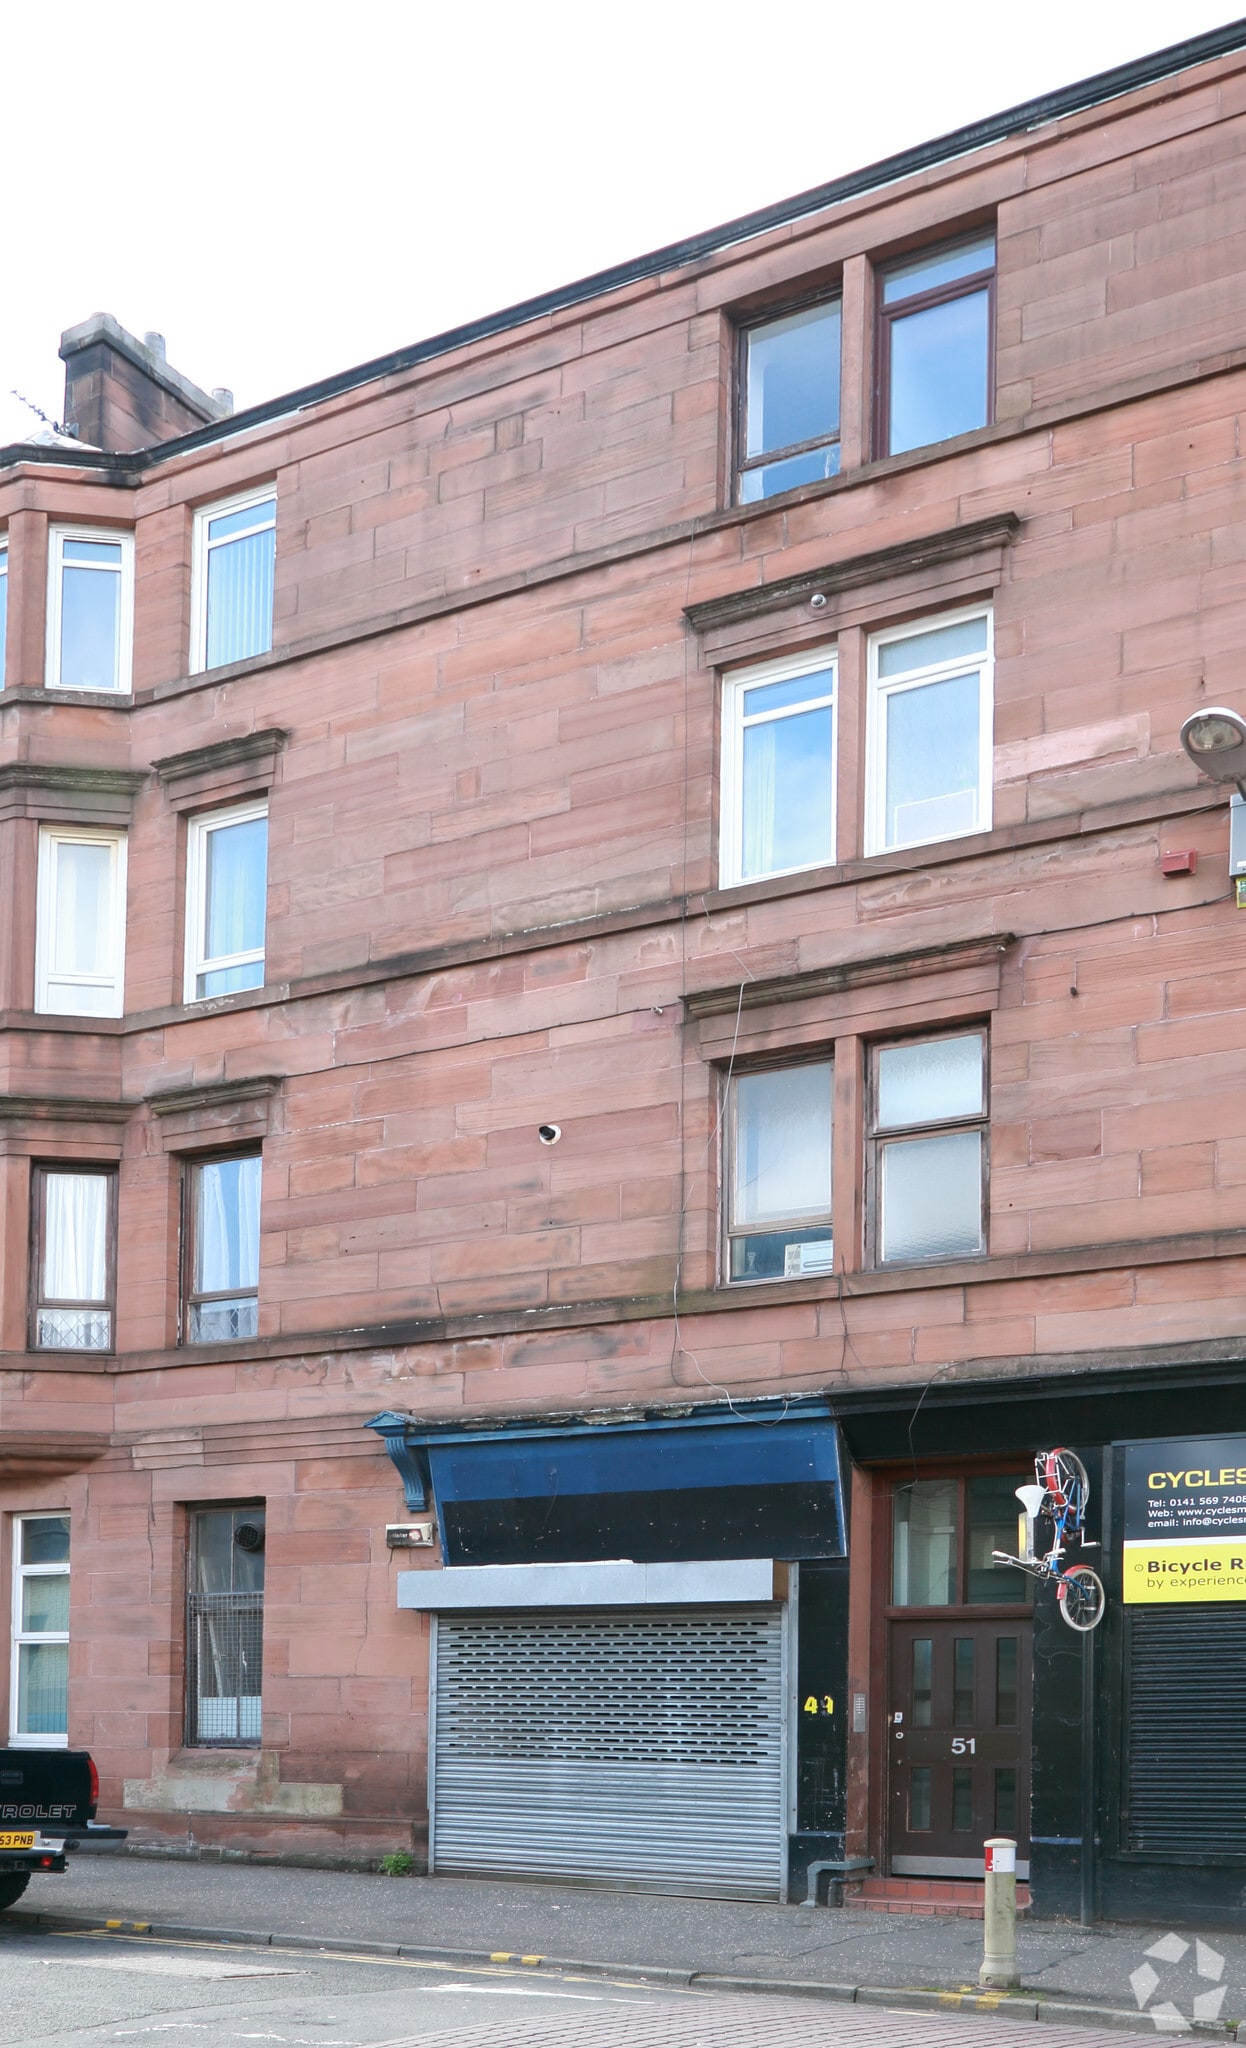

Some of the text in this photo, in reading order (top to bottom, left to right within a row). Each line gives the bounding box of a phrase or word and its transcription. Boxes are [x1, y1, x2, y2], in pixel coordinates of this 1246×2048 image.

[1148, 1467, 1246, 1489] CYCLES
[1147, 1499, 1166, 1508] Tel:
[1169, 1498, 1195, 1507] 0141
[1199, 1497, 1219, 1505] 569
[1148, 1509, 1174, 1518] Web:
[1147, 1516, 1246, 1528] email: info@cycles
[1147, 1558, 1246, 1575] Bicycle R
[1147, 1575, 1246, 1589] by experienc
[951, 1737, 976, 1755] 51
[0, 1804, 77, 1819] ROLET
[13, 1835, 34, 1845] PNB
